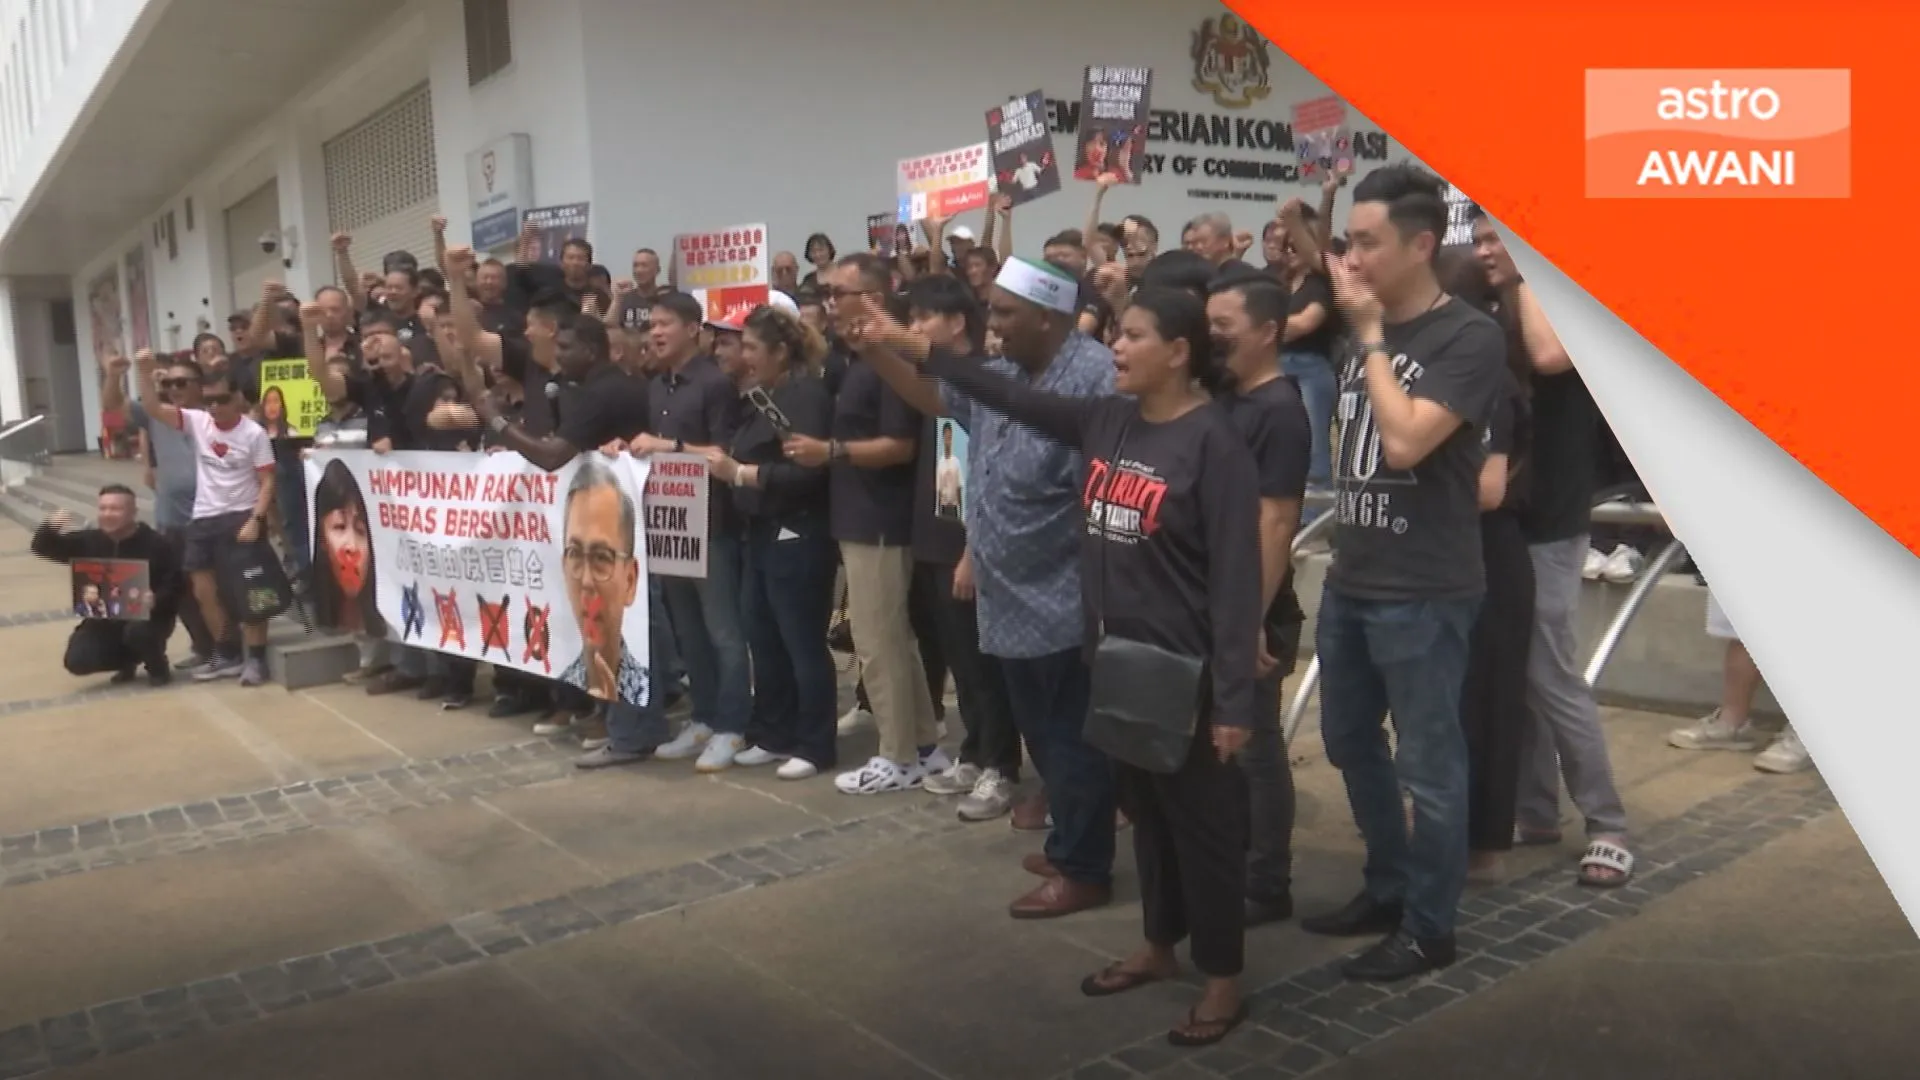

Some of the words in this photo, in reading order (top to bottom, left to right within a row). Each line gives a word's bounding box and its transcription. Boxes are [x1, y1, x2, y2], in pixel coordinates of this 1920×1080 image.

[1236, 116, 1388, 161] KOMASI
[1172, 155, 1198, 175] OF
[659, 461, 705, 479] MENTERI
[368, 469, 479, 500] HIMPUNAN
[482, 473, 559, 506] RAKYAT
[662, 481, 697, 499] GAGAL
[378, 503, 438, 535] BEBAS
[443, 508, 552, 544] BERSUARA
[646, 503, 689, 533] LETAK
[646, 532, 701, 563] WATAN
[1588, 845, 1625, 865] NIKE
